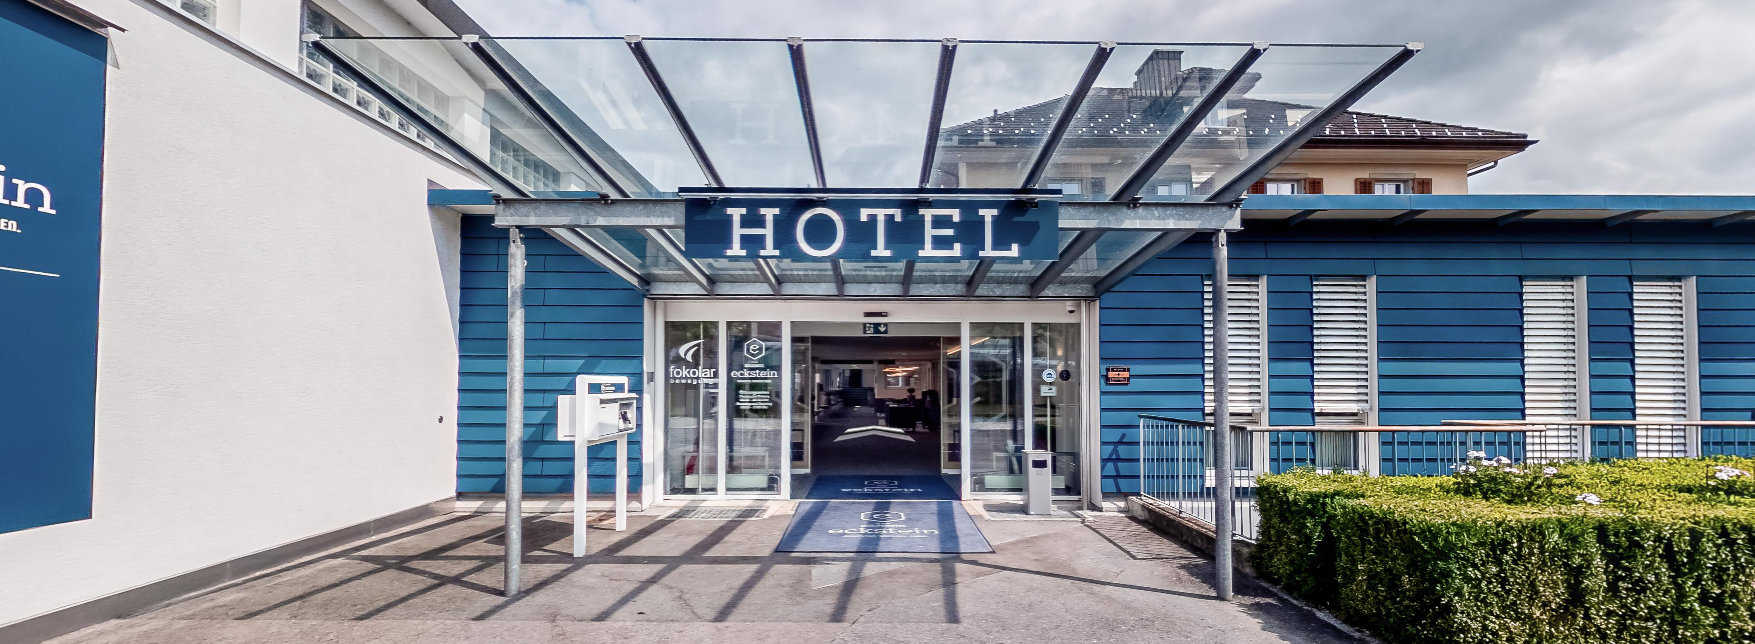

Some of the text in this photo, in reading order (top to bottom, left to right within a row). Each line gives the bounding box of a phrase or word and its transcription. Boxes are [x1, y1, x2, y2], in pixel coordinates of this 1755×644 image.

[724, 207, 1019, 257] HOTEL
[669, 365, 717, 378] fokolar
[730, 368, 779, 378] eckstein
